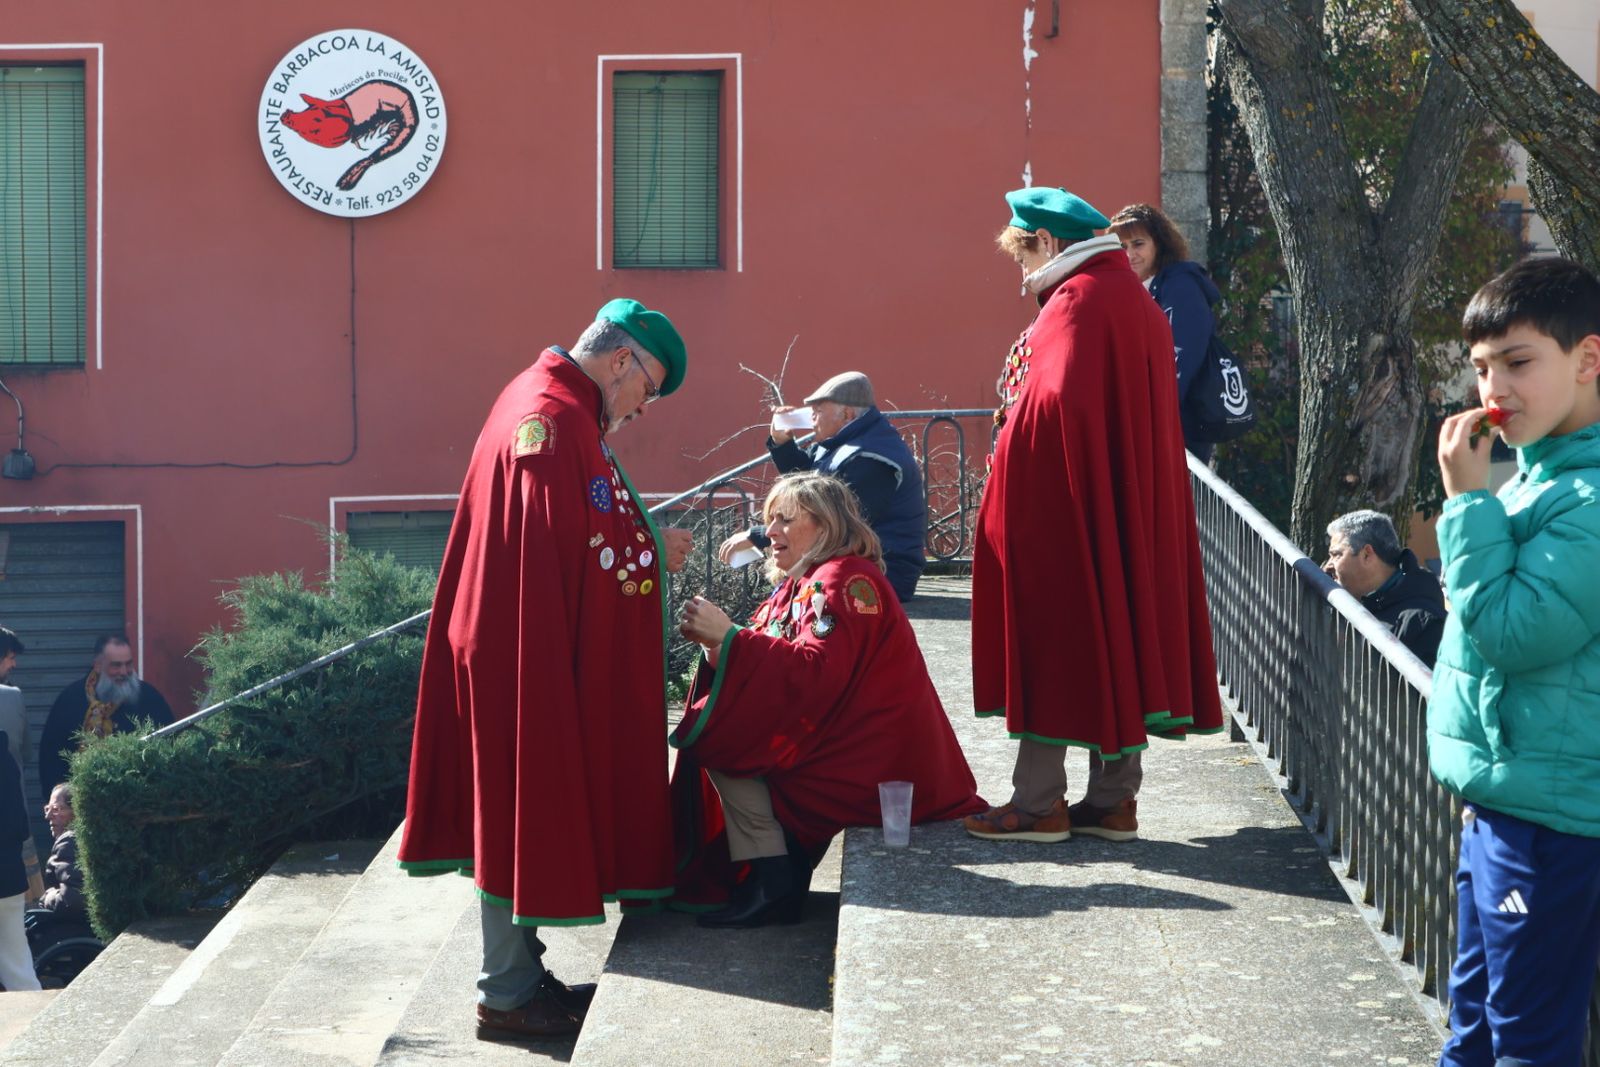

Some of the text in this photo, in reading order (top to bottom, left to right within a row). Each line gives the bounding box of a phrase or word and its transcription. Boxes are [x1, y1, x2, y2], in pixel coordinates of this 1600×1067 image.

[266, 36, 440, 206] RESTAURANTE BARBACOA LA AMISTAD
[329, 69, 408, 97] Mariscos de Pocilga
[346, 134, 440, 210] Telf. 923 58 04 02
